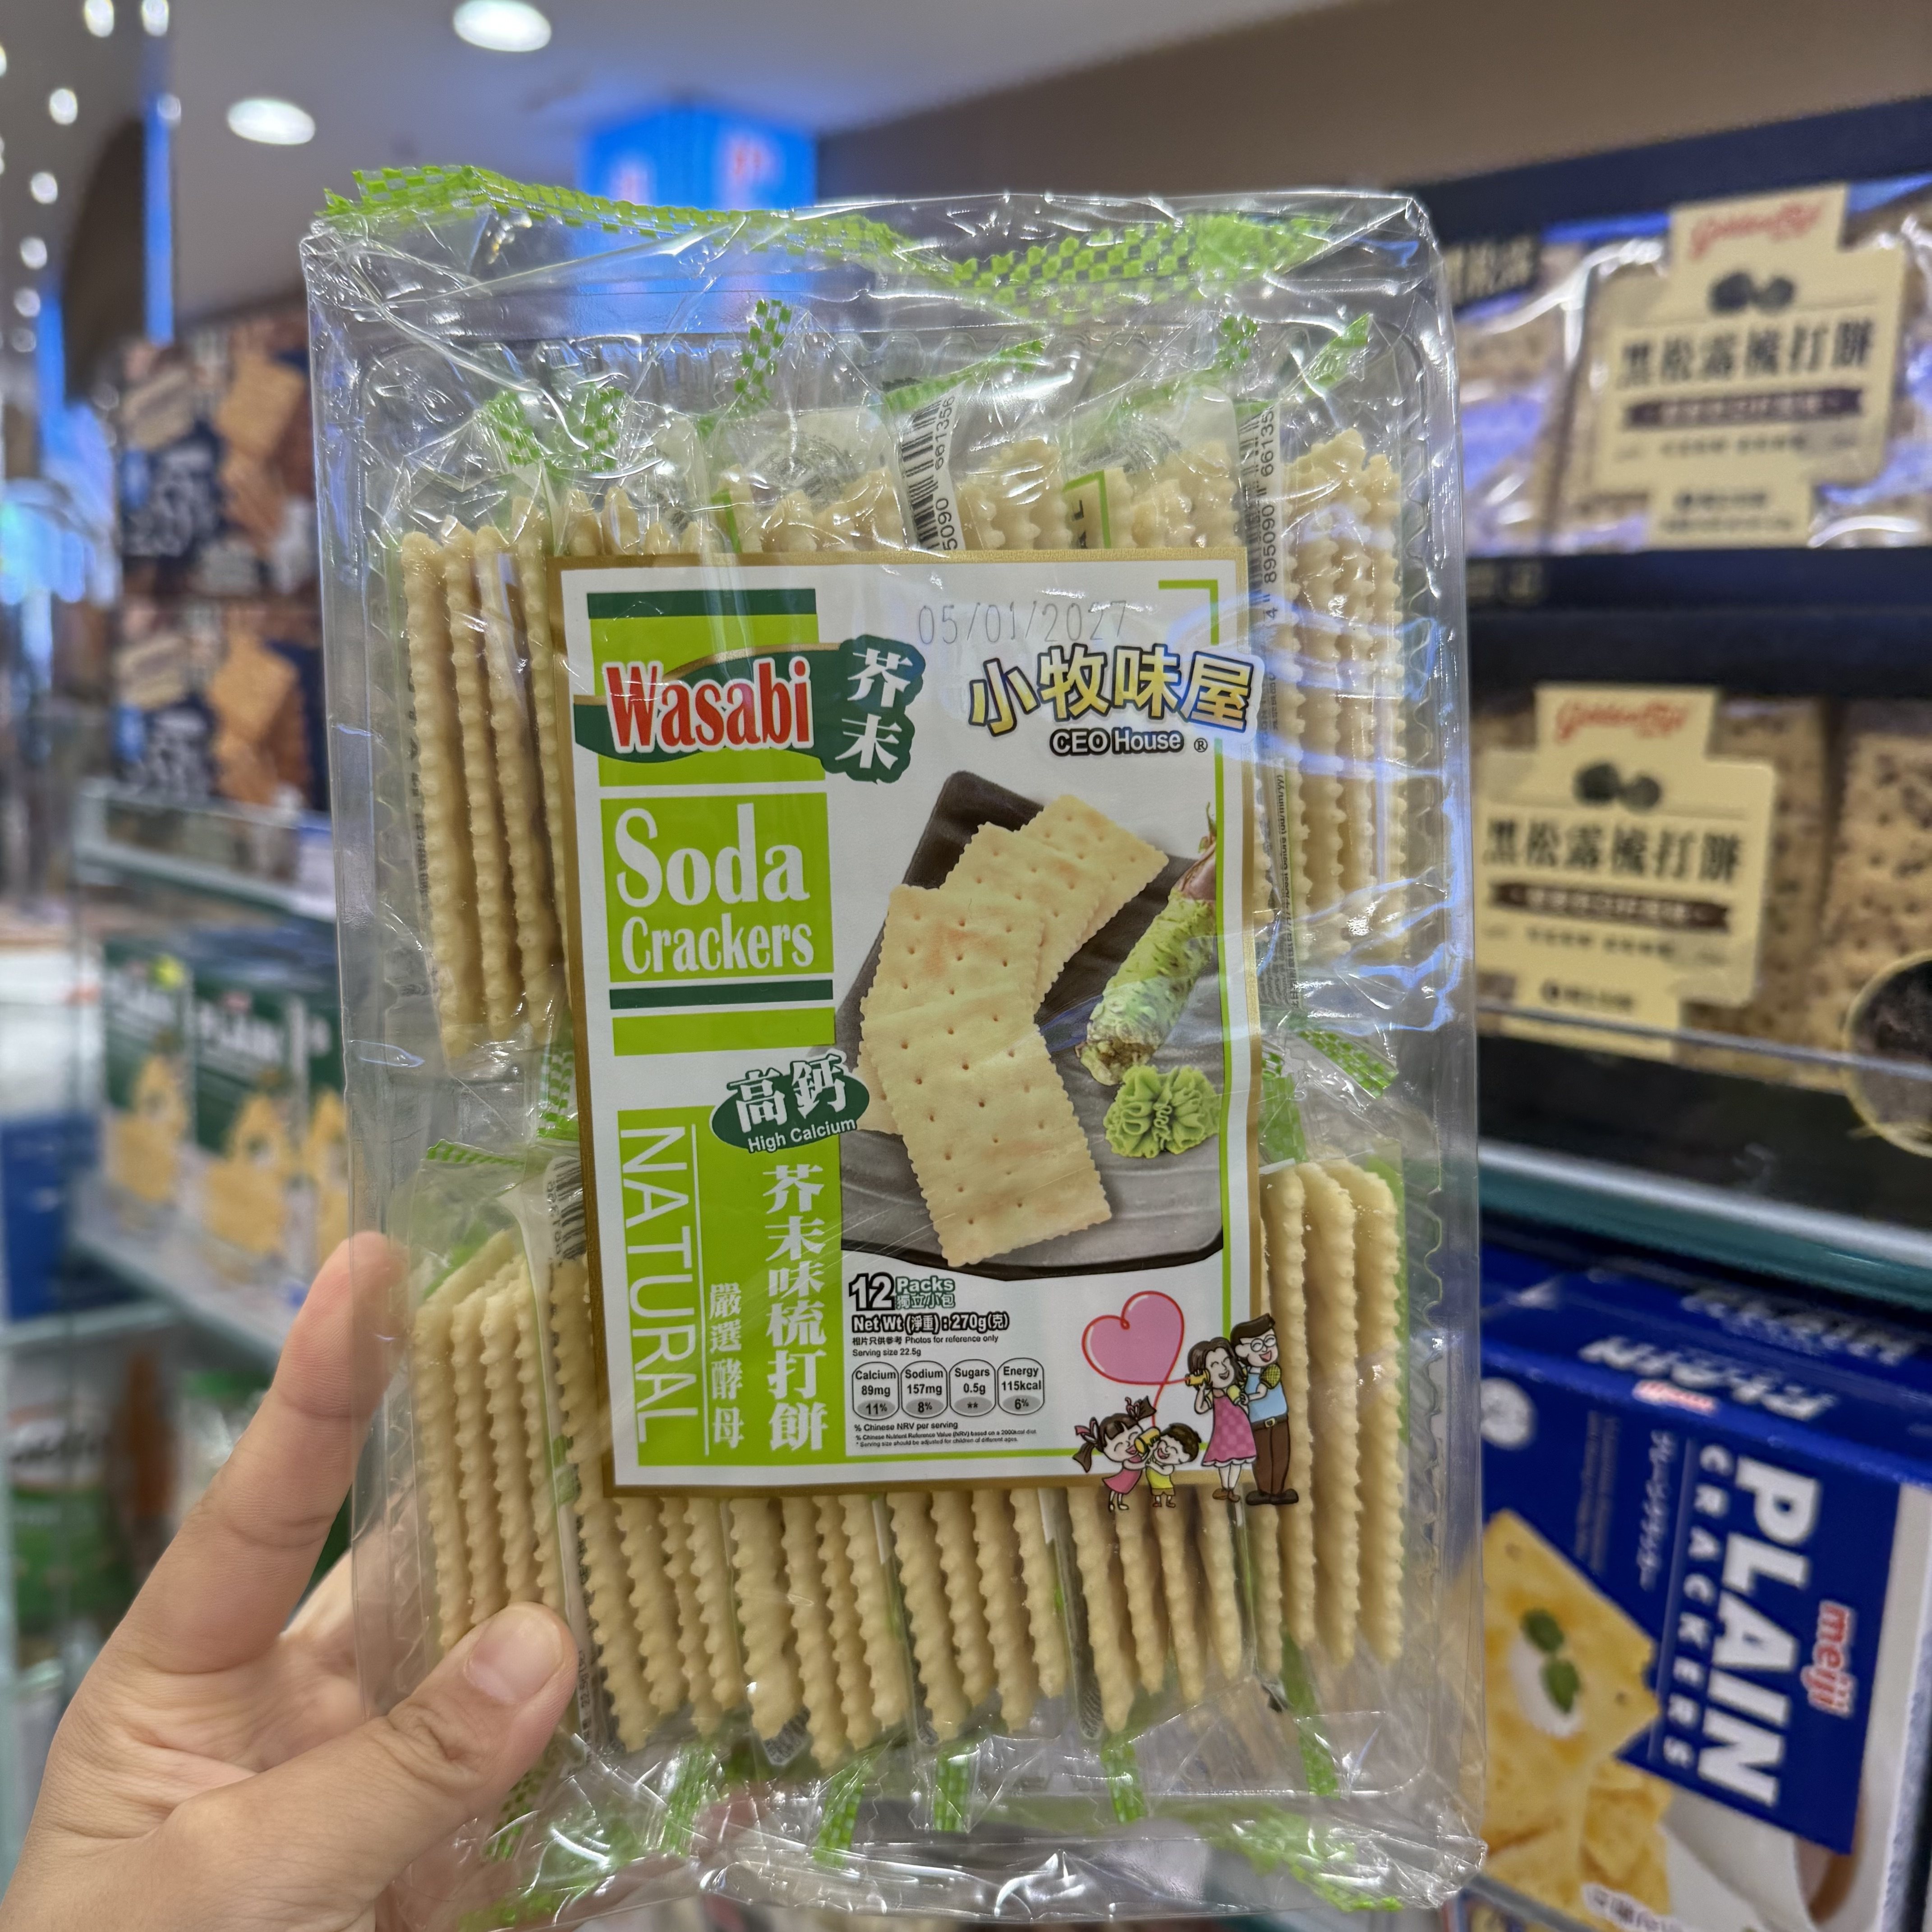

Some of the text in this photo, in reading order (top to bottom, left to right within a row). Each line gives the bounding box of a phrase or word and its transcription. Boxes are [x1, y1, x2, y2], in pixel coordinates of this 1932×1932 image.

[1261, 408, 1275, 477] 66135
[1262, 505, 1278, 584] 895090
[919, 600, 1127, 644] 05/01/2027
[603, 657, 813, 752] Wasabi
[969, 644, 1255, 736] 小牧味屋
[835, 648, 913, 771] 芥末
[1051, 729, 1109, 756] CEO
[1114, 728, 1185, 754] House
[615, 802, 811, 908] Soda
[622, 912, 814, 974] Crackers
[727, 1053, 846, 1133] 高鈣
[748, 1119, 856, 1153] High Calcium
[621, 1126, 698, 1443] NATURAL
[849, 1272, 956, 1311] 12 Packs
[763, 1164, 828, 1452] 芥末味梳打餅
[896, 1293, 956, 1309] 獨立小包
[852, 1314, 881, 1333] Net
[905, 1336, 932, 1344] Photos
[945, 1334, 981, 1343] reference
[983, 1334, 998, 1343] only
[708, 1282, 745, 1449] 嚴選酵母
[852, 1348, 921, 1358] Serving size 22.5g
[856, 1370, 896, 1380] Calcium
[905, 1369, 943, 1379] Sodium
[955, 1367, 990, 1379] Sugars
[1001, 1380, 1042, 1391] 115kcal
[1003, 1366, 1039, 1377] Energy
[861, 1385, 891, 1397] 89mg
[906, 1384, 943, 1396] 157mg
[963, 1383, 986, 1395] 0.5g
[1014, 1398, 1029, 1410] 6%
[866, 1403, 888, 1415] 11%
[918, 1401, 933, 1413] 8%
[854, 1424, 862, 1432] %
[931, 1421, 958, 1430] serving
[1663, 1444, 1734, 1769] CRACKERS
[1697, 1454, 1820, 1807] PLAIN
[1800, 1598, 1856, 1719] meiji
